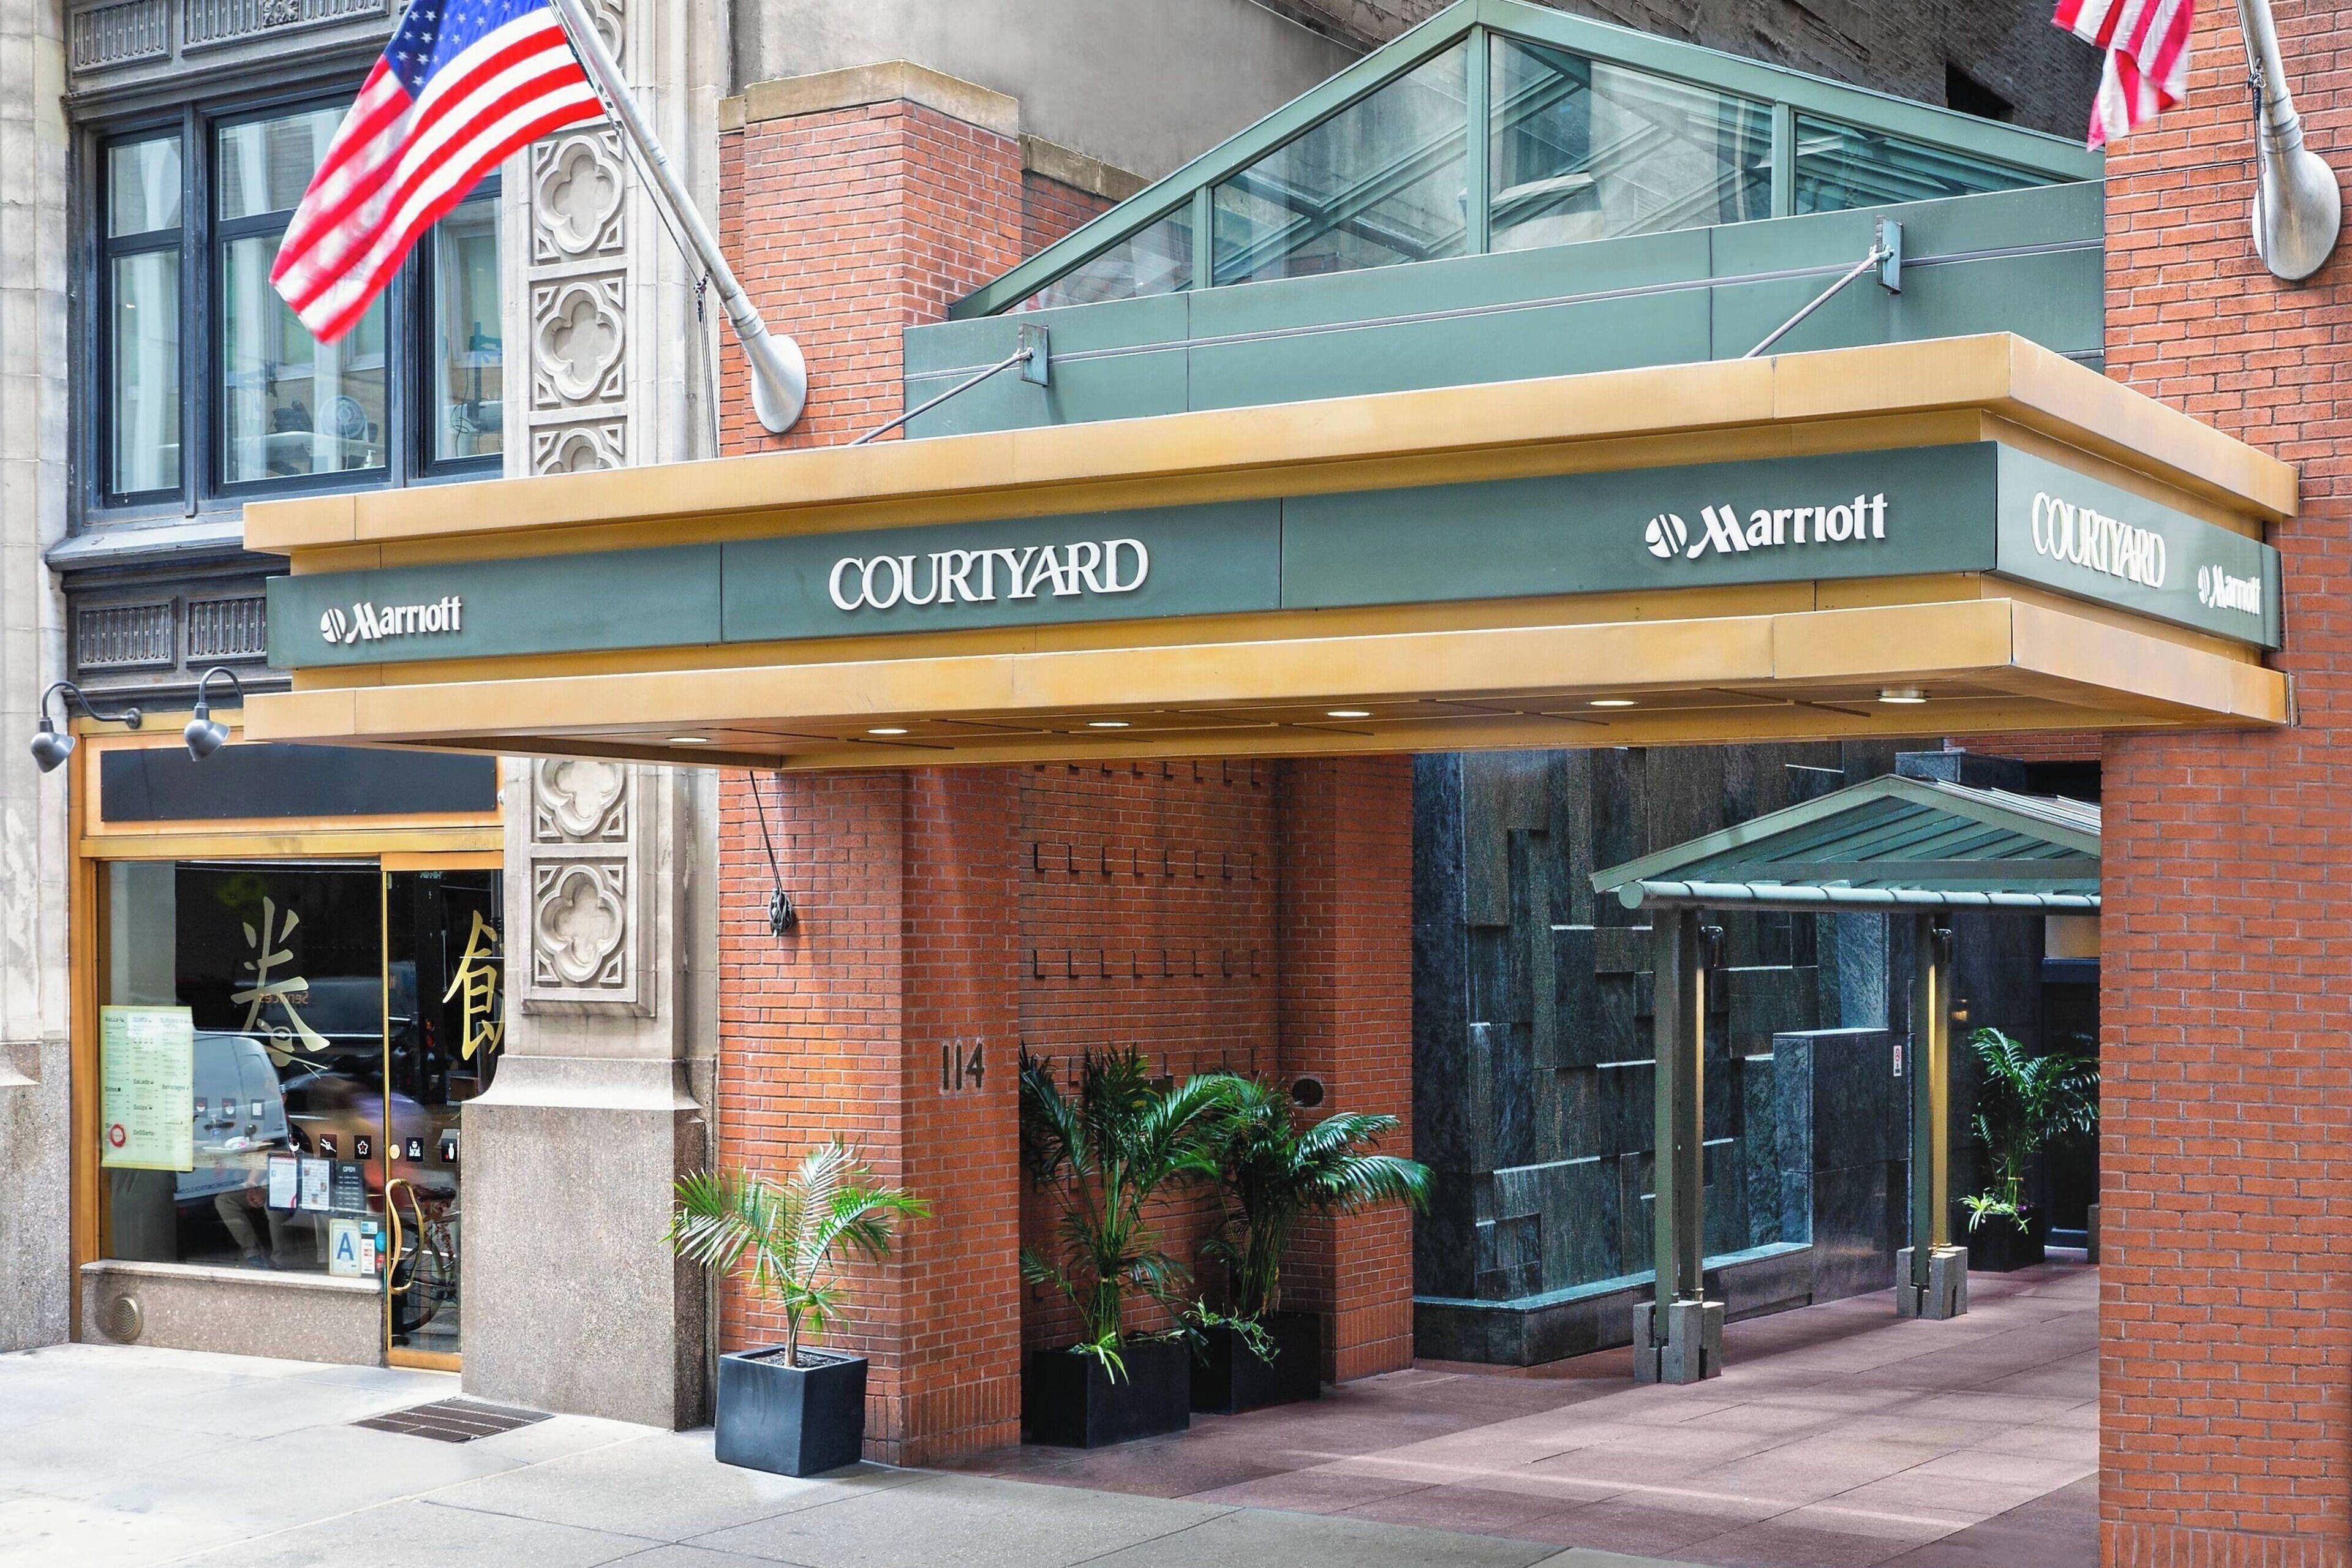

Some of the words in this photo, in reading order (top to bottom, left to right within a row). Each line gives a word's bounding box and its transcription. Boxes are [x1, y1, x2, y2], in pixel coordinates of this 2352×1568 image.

[1686, 492, 1888, 559] Marriott
[2031, 492, 2166, 589] COURTYARD
[829, 538, 1149, 611] COURTYARD
[2209, 564, 2261, 615] Marriott
[344, 595, 462, 644] Marriott
[943, 1042, 985, 1091] 114
[336, 1232, 354, 1261] A
